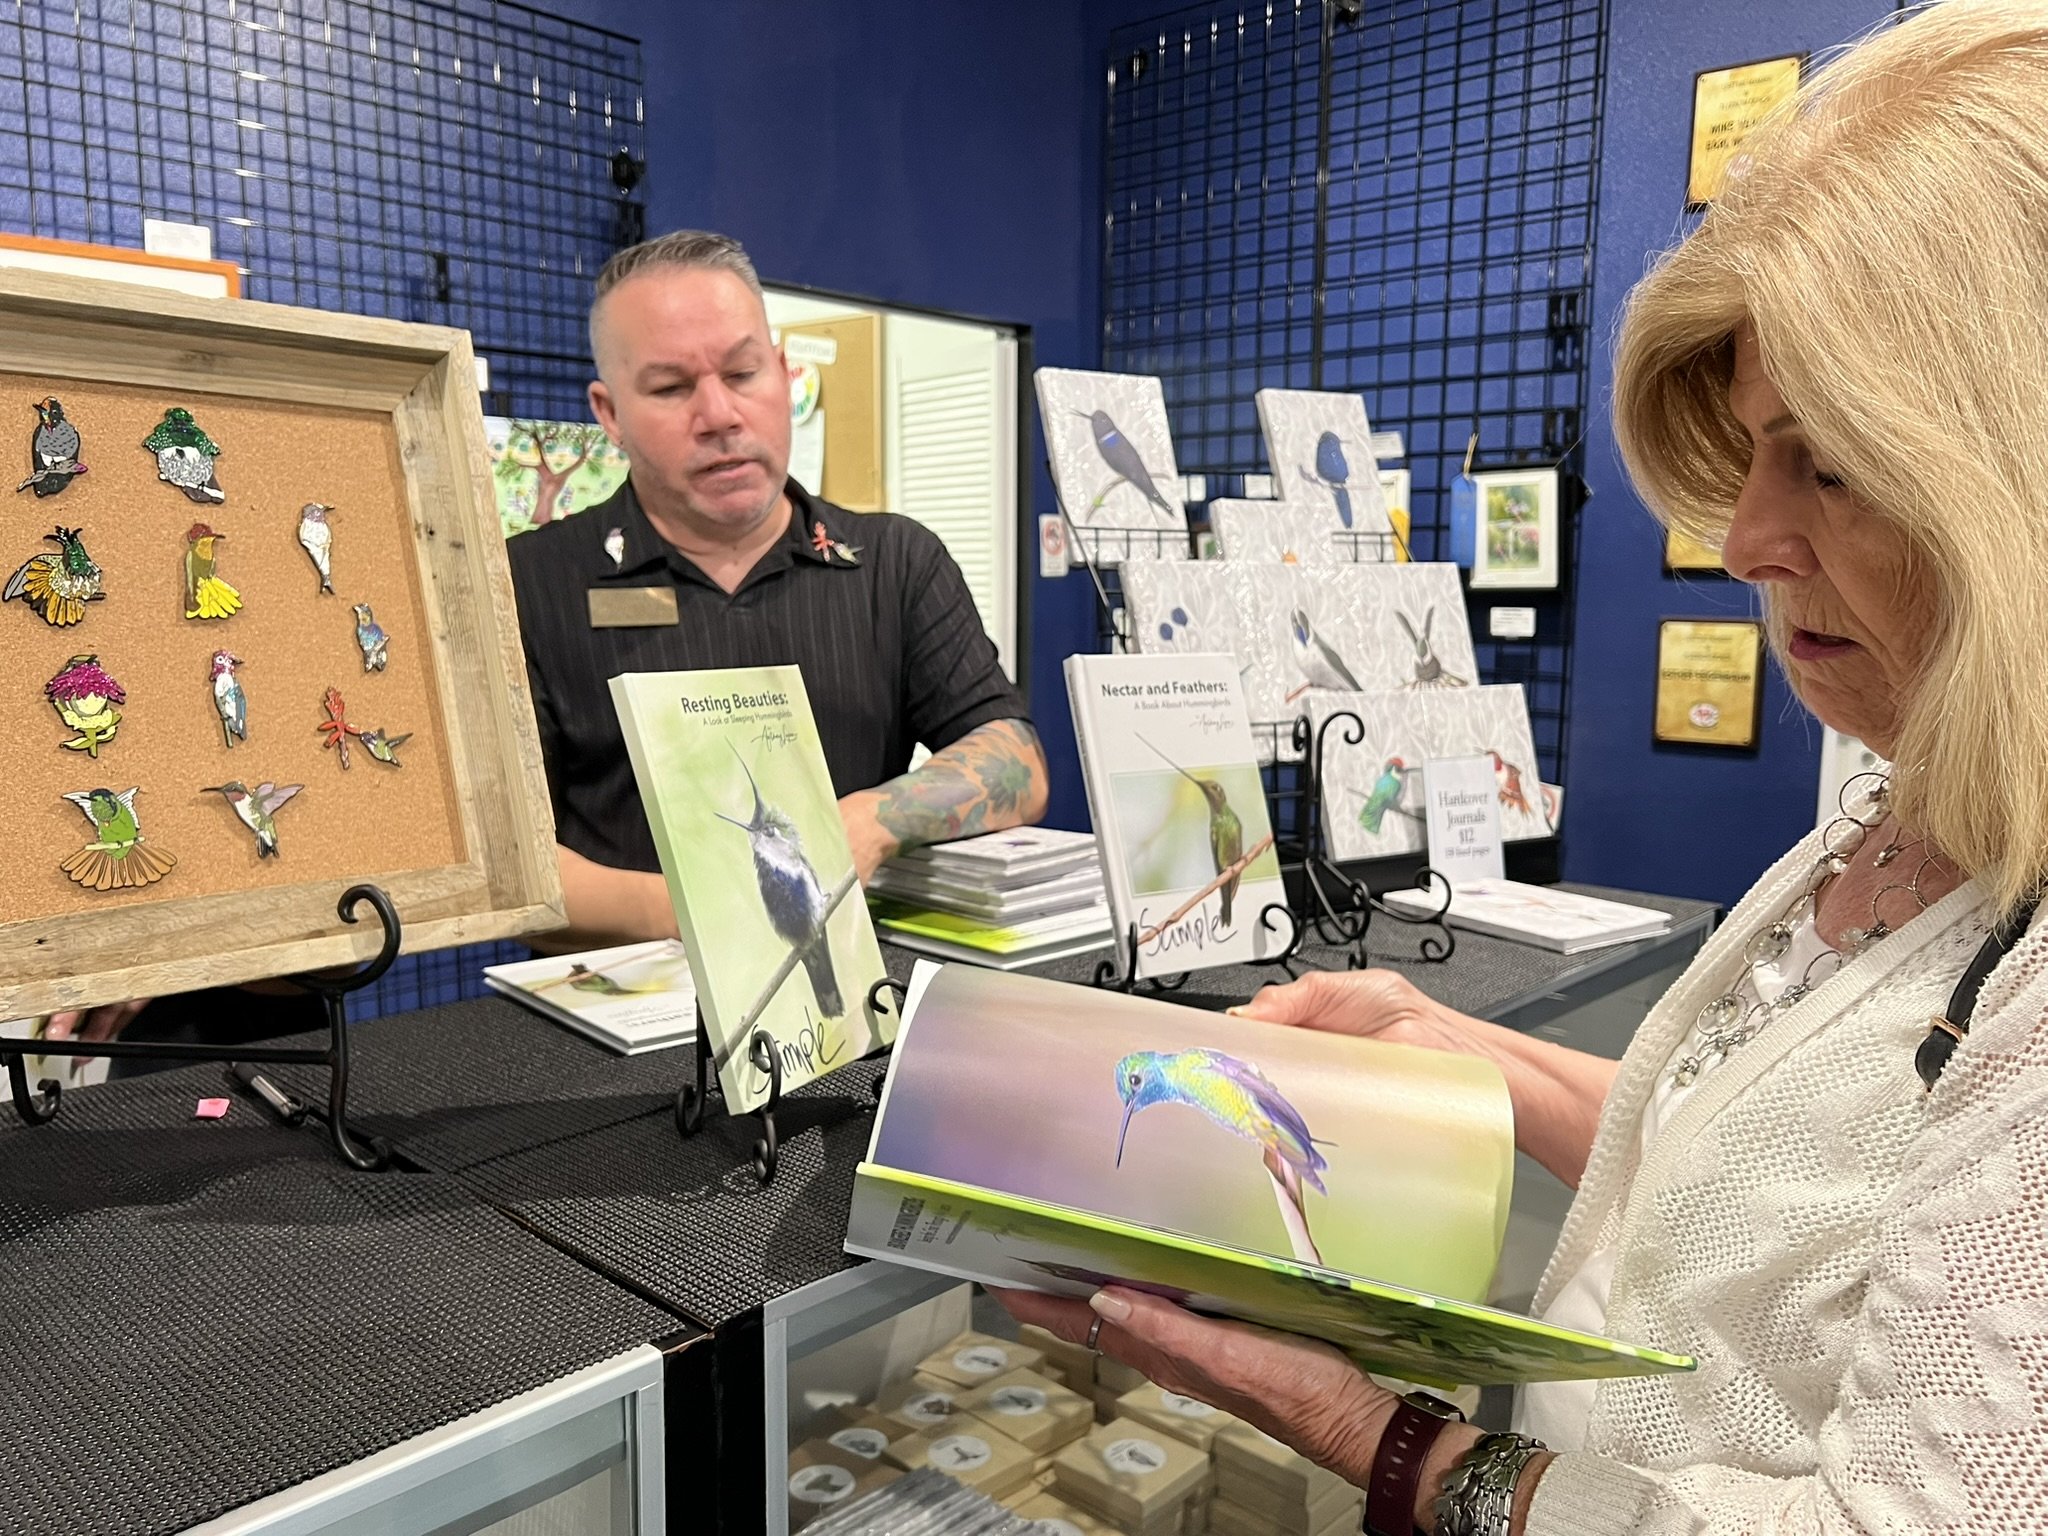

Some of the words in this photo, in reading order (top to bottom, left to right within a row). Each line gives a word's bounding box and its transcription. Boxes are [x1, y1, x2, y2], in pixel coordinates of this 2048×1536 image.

[1101, 683, 1143, 697] Nectar
[1146, 682, 1170, 696] and
[1172, 680, 1228, 694] Feathers:
[681, 696, 732, 714] Resting
[732, 690, 789, 709] Beauties:
[1142, 700, 1159, 710] Book
[703, 717, 709, 726] A
[709, 715, 722, 725] Look
[730, 713, 755, 725] Sleeping
[1439, 790, 1488, 807] Hardcover
[1447, 808, 1487, 830] Journals
[1459, 827, 1475, 844] $12
[1139, 902, 1238, 957] Sample
